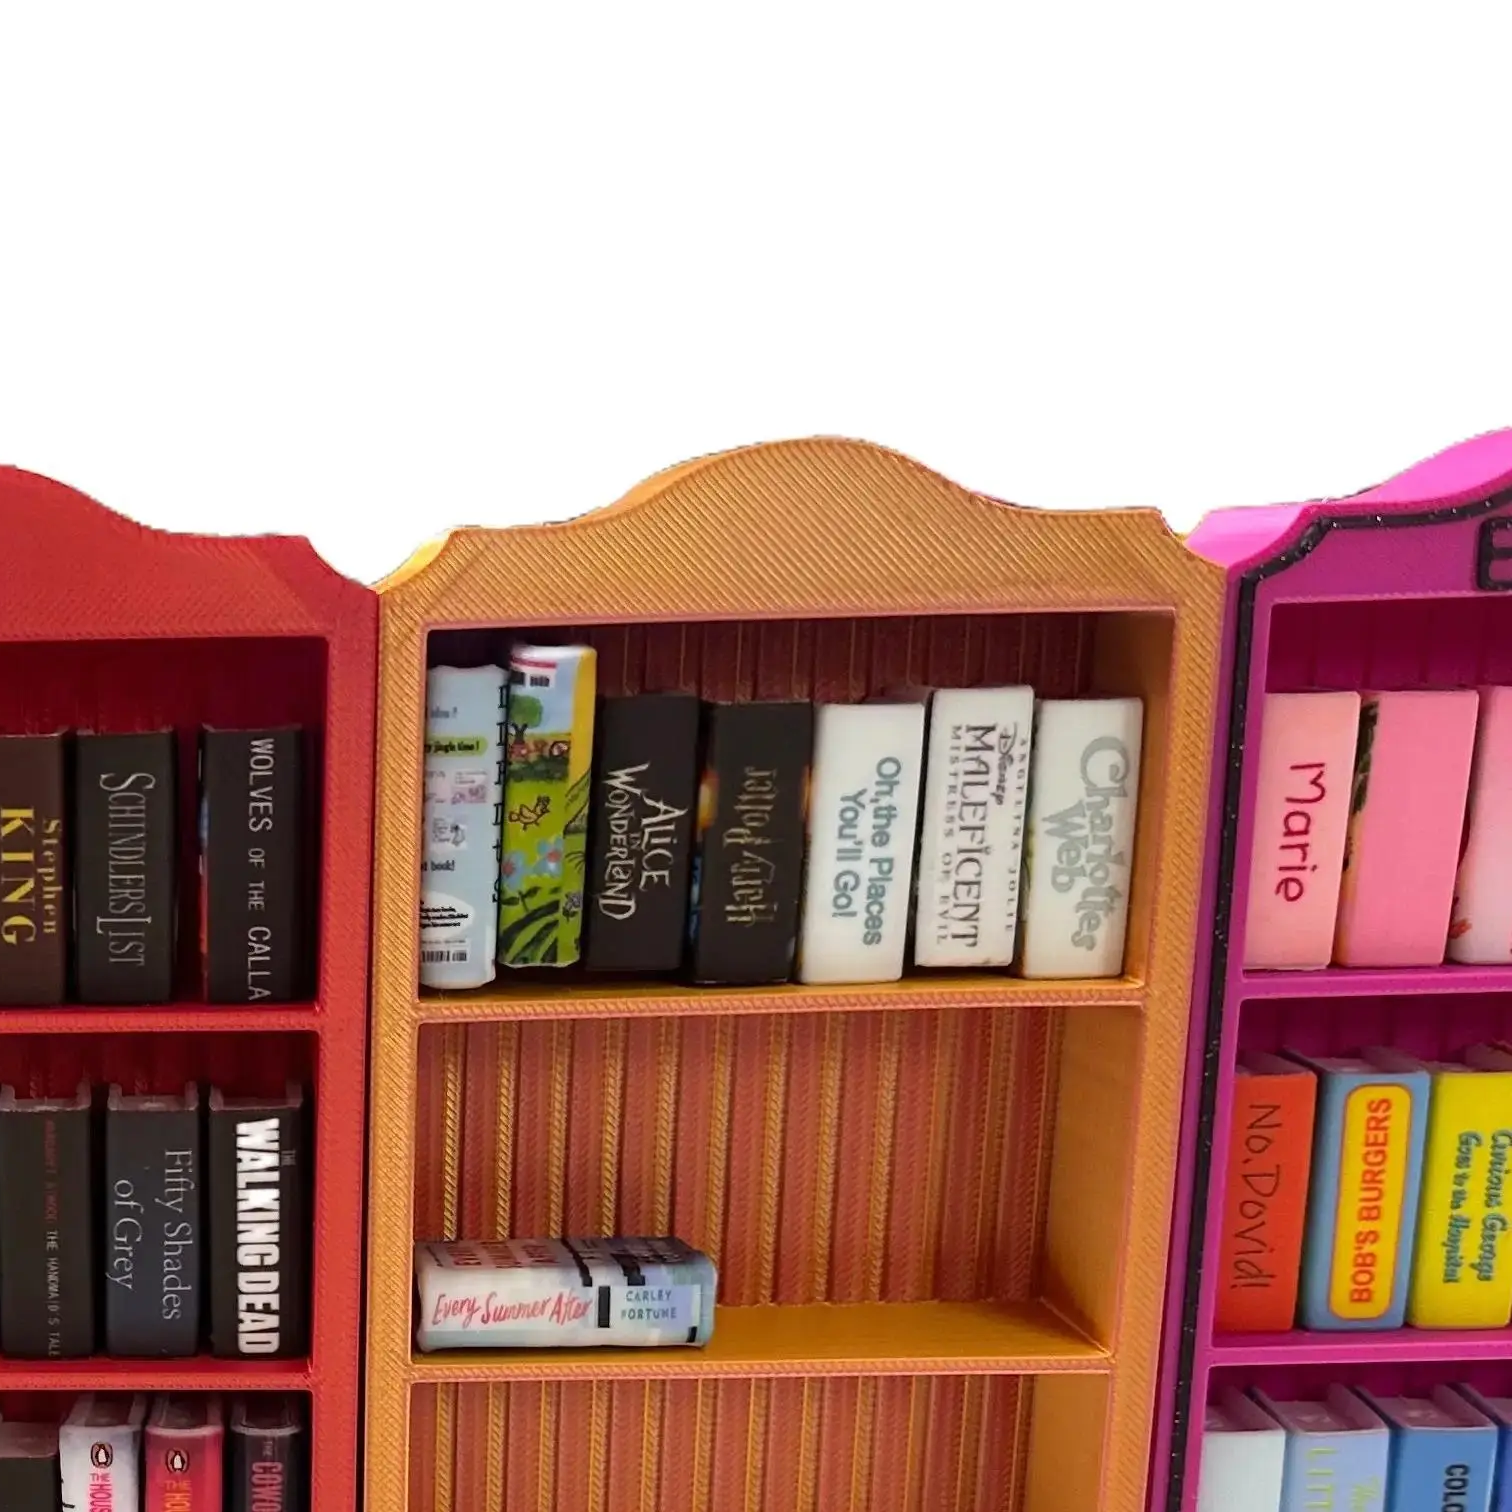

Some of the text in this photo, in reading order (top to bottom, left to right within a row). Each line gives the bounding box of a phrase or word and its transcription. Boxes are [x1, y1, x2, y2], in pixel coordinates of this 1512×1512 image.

[0, 806, 36, 946] KING
[37, 818, 63, 934] Stephen
[248, 737, 275, 1001] WOLVES OF THE CALLA
[722, 766, 779, 928] Harry Potter
[831, 788, 868, 919] You'll Go!
[951, 724, 997, 948] MALEFICENT
[1042, 799, 1087, 894] Web
[1273, 762, 1326, 903] Marie
[46, 1230, 59, 1251] THE
[105, 1179, 145, 1291] of Grey
[155, 1150, 195, 1320] Fifty Shades
[236, 1117, 281, 1354] WALKING DEAD
[1348, 1098, 1393, 1304] BOB'S BURGERS
[48, 1331, 61, 1357] TALE
[431, 1287, 594, 1328] Every Summer After
[620, 1306, 677, 1321] FORTUNE
[625, 1289, 672, 1302] CARLEY
